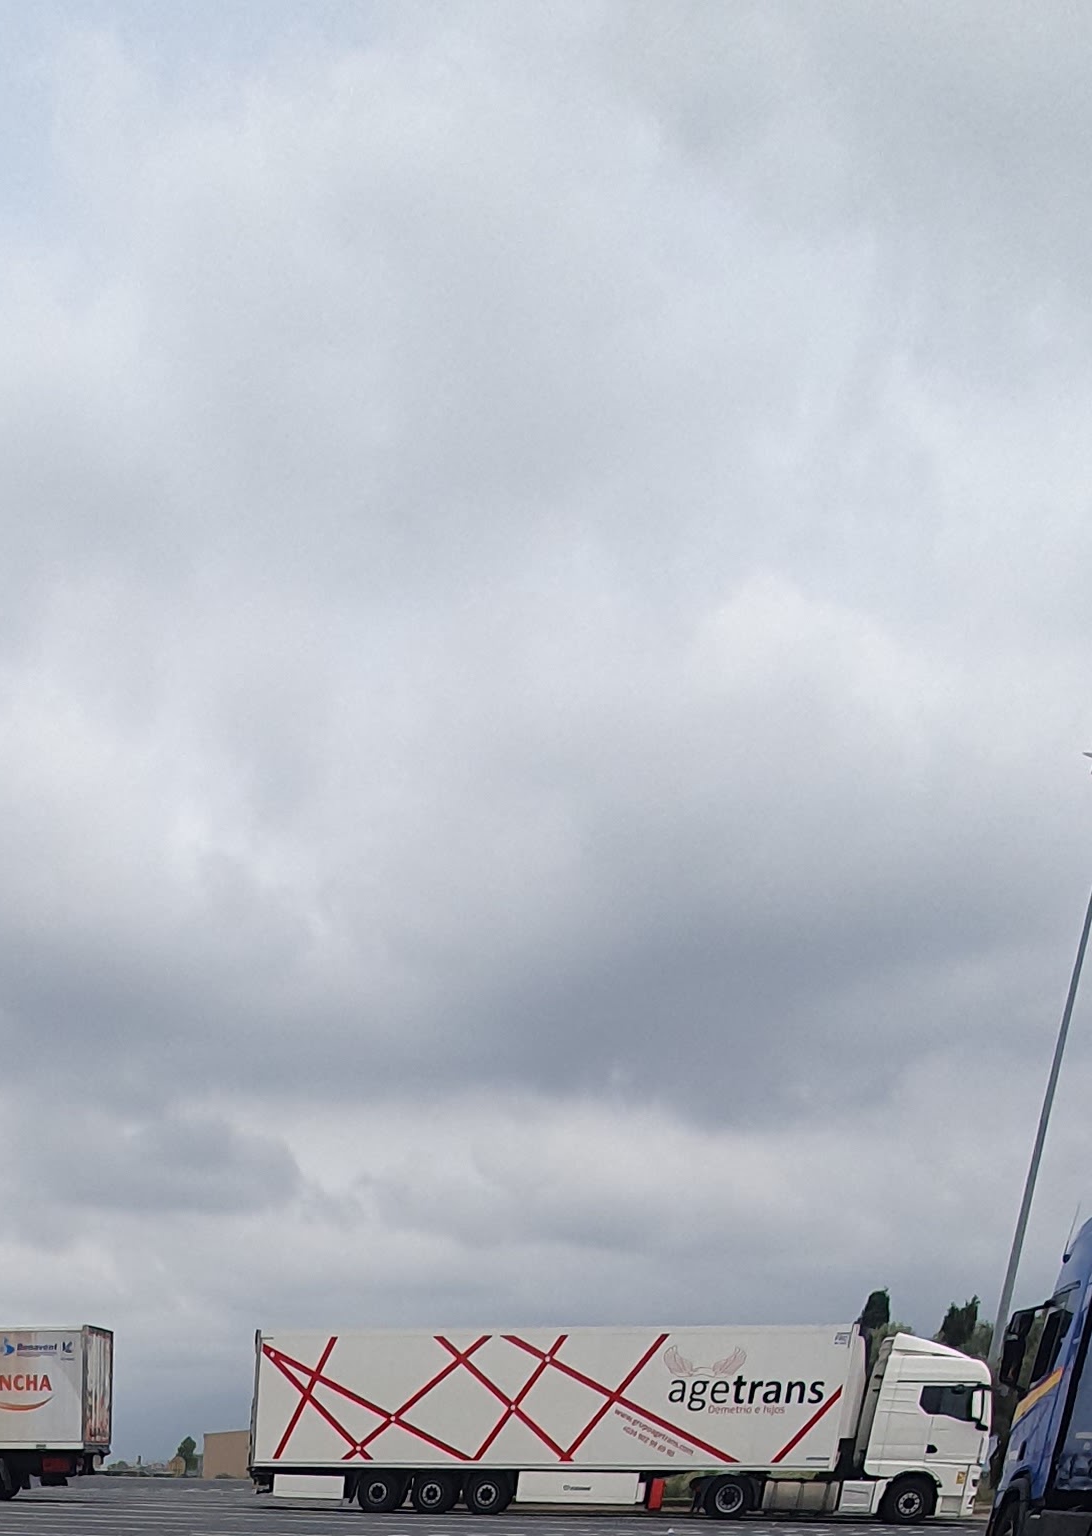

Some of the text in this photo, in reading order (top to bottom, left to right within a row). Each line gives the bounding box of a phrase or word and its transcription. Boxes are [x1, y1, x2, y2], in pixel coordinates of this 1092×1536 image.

[668, 1375, 825, 1412] agetrans
[708, 1405, 785, 1416] Demetrio e hijos
